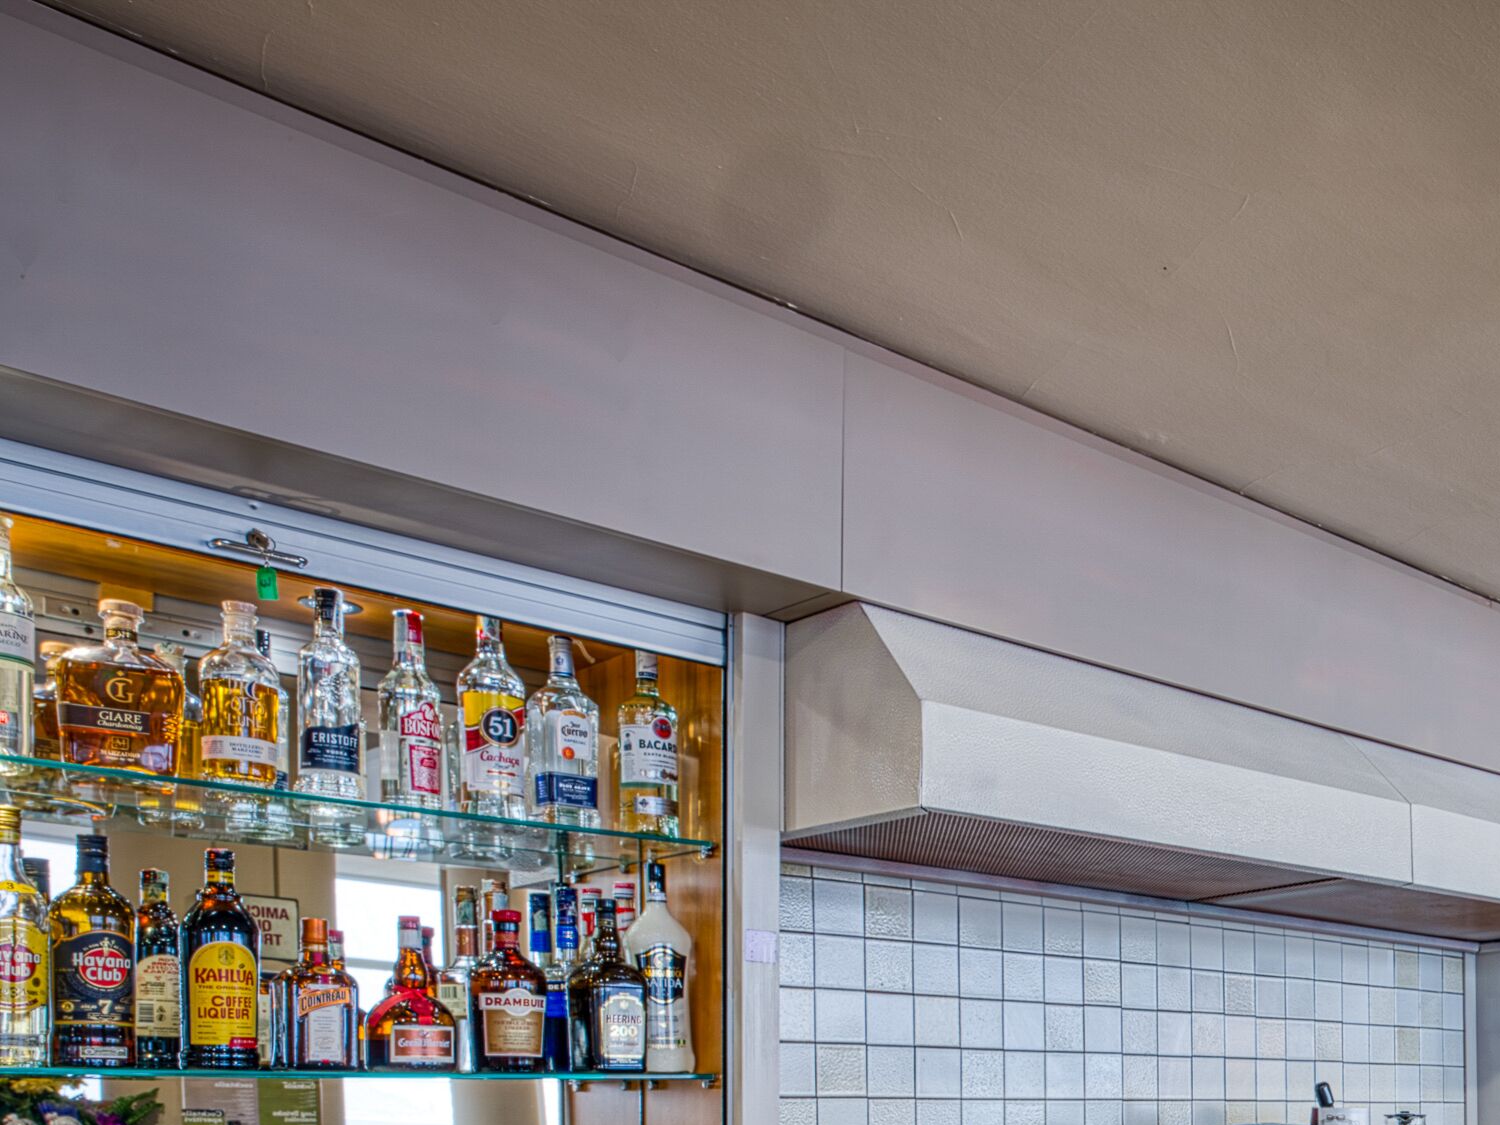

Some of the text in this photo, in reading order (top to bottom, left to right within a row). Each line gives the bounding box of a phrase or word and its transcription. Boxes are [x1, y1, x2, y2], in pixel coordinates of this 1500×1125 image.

[98, 710, 143, 725] GIARE
[97, 719, 144, 732] Chardonnay
[488, 716, 514, 739] 51
[560, 725, 589, 739] Cuervo
[312, 731, 359, 749] ERISTOFF
[72, 951, 132, 969] Havana
[85, 966, 123, 982] Club
[99, 999, 113, 1015] 7
[211, 995, 253, 1010] COFFEE
[301, 989, 347, 1011] COINTREAU
[197, 1006, 250, 1021] LIQUEUR
[606, 1014, 643, 1025] HEERING
[609, 1026, 638, 1037] 200
